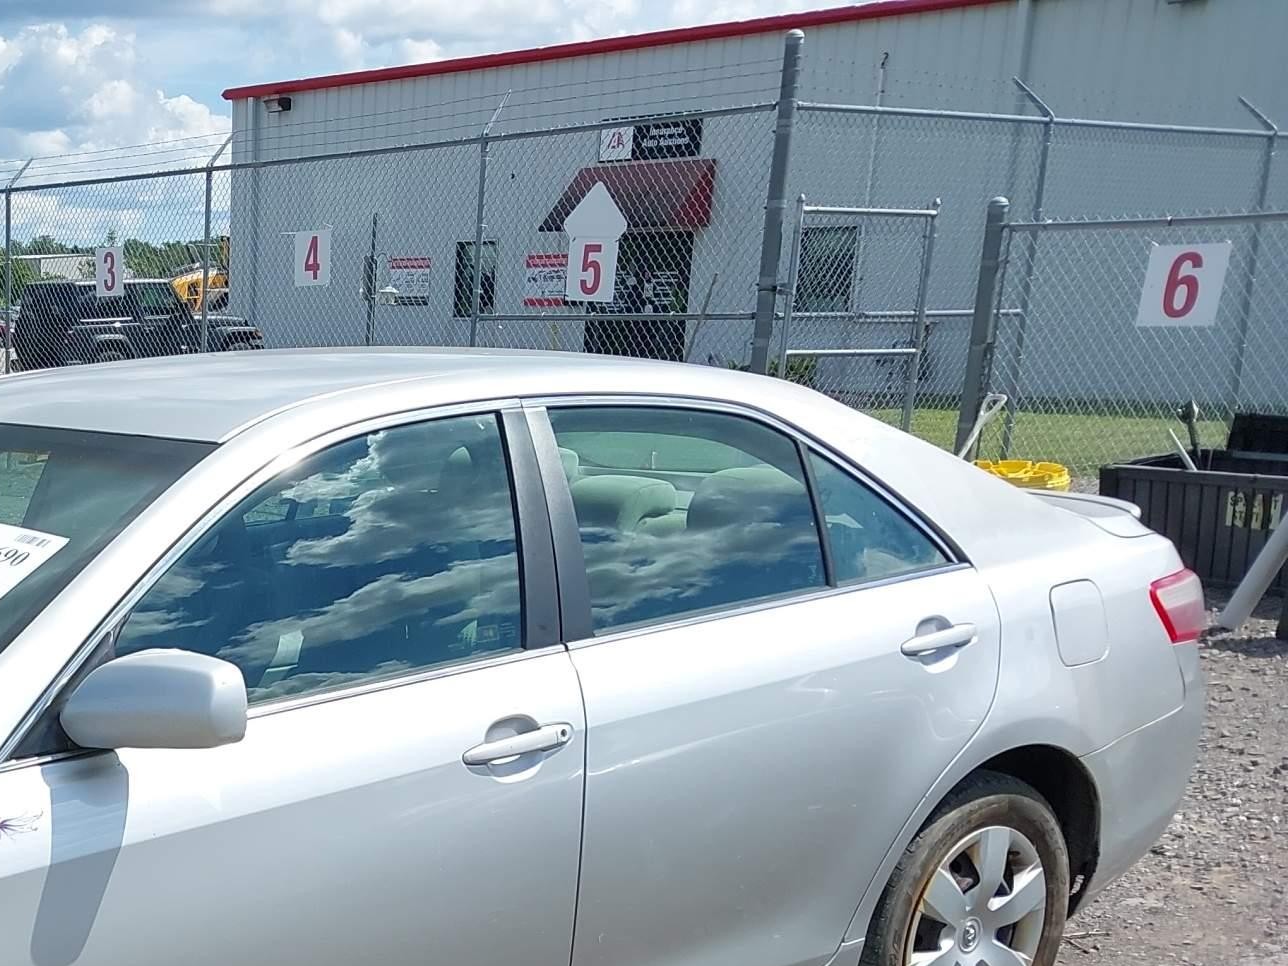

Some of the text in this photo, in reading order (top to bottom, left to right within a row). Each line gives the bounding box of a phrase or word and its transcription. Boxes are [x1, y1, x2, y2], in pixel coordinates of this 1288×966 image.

[103, 251, 116, 292] 3
[304, 235, 320, 280] 4
[579, 244, 603, 296] 5
[1163, 251, 1203, 319] 6
